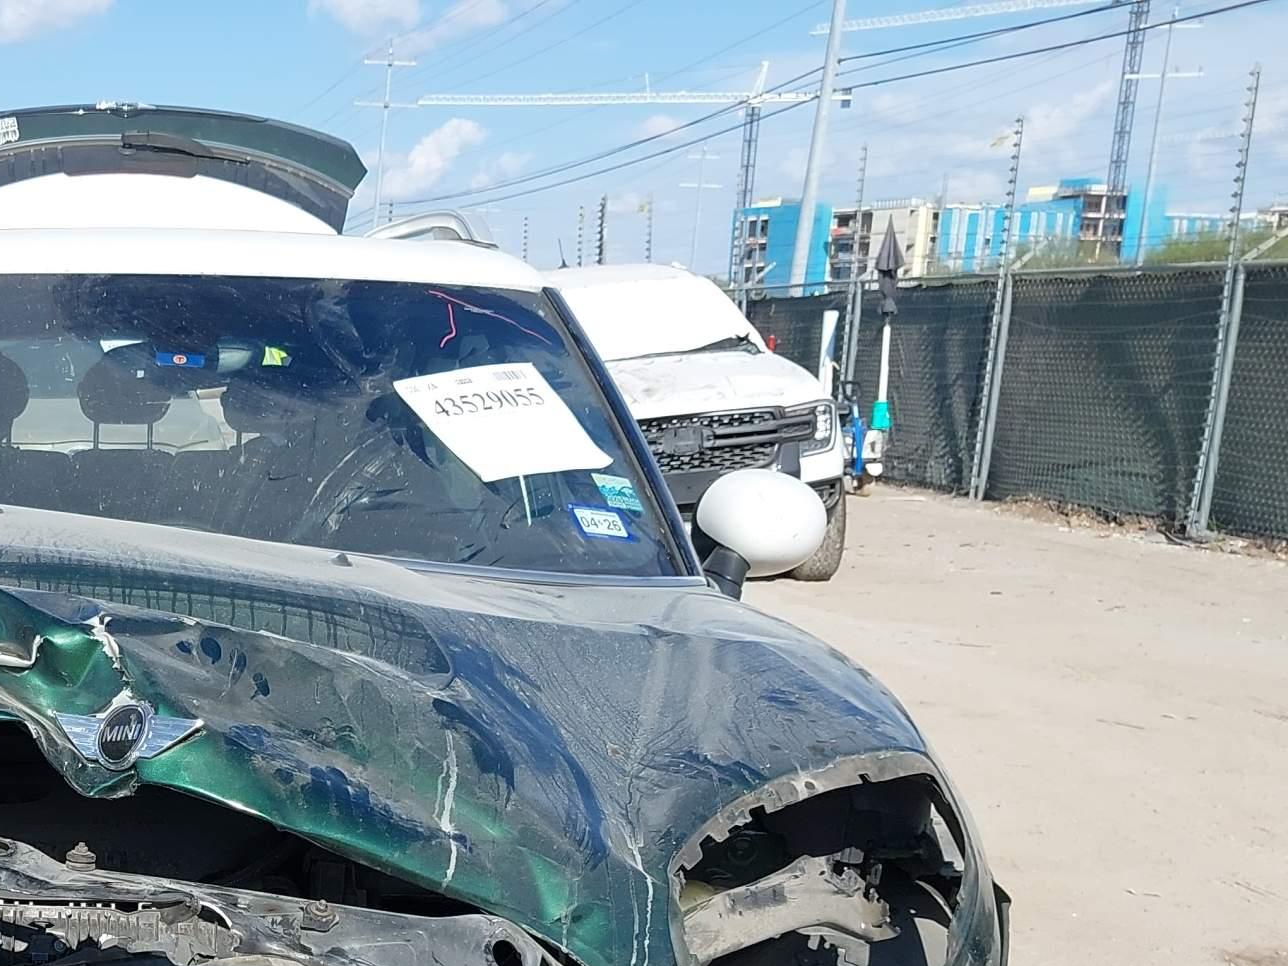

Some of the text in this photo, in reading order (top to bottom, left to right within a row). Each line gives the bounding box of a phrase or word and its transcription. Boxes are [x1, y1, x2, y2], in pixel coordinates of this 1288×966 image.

[434, 387, 545, 417] 43529055
[580, 516, 623, 532] 04 26
[102, 724, 141, 742] MINI
